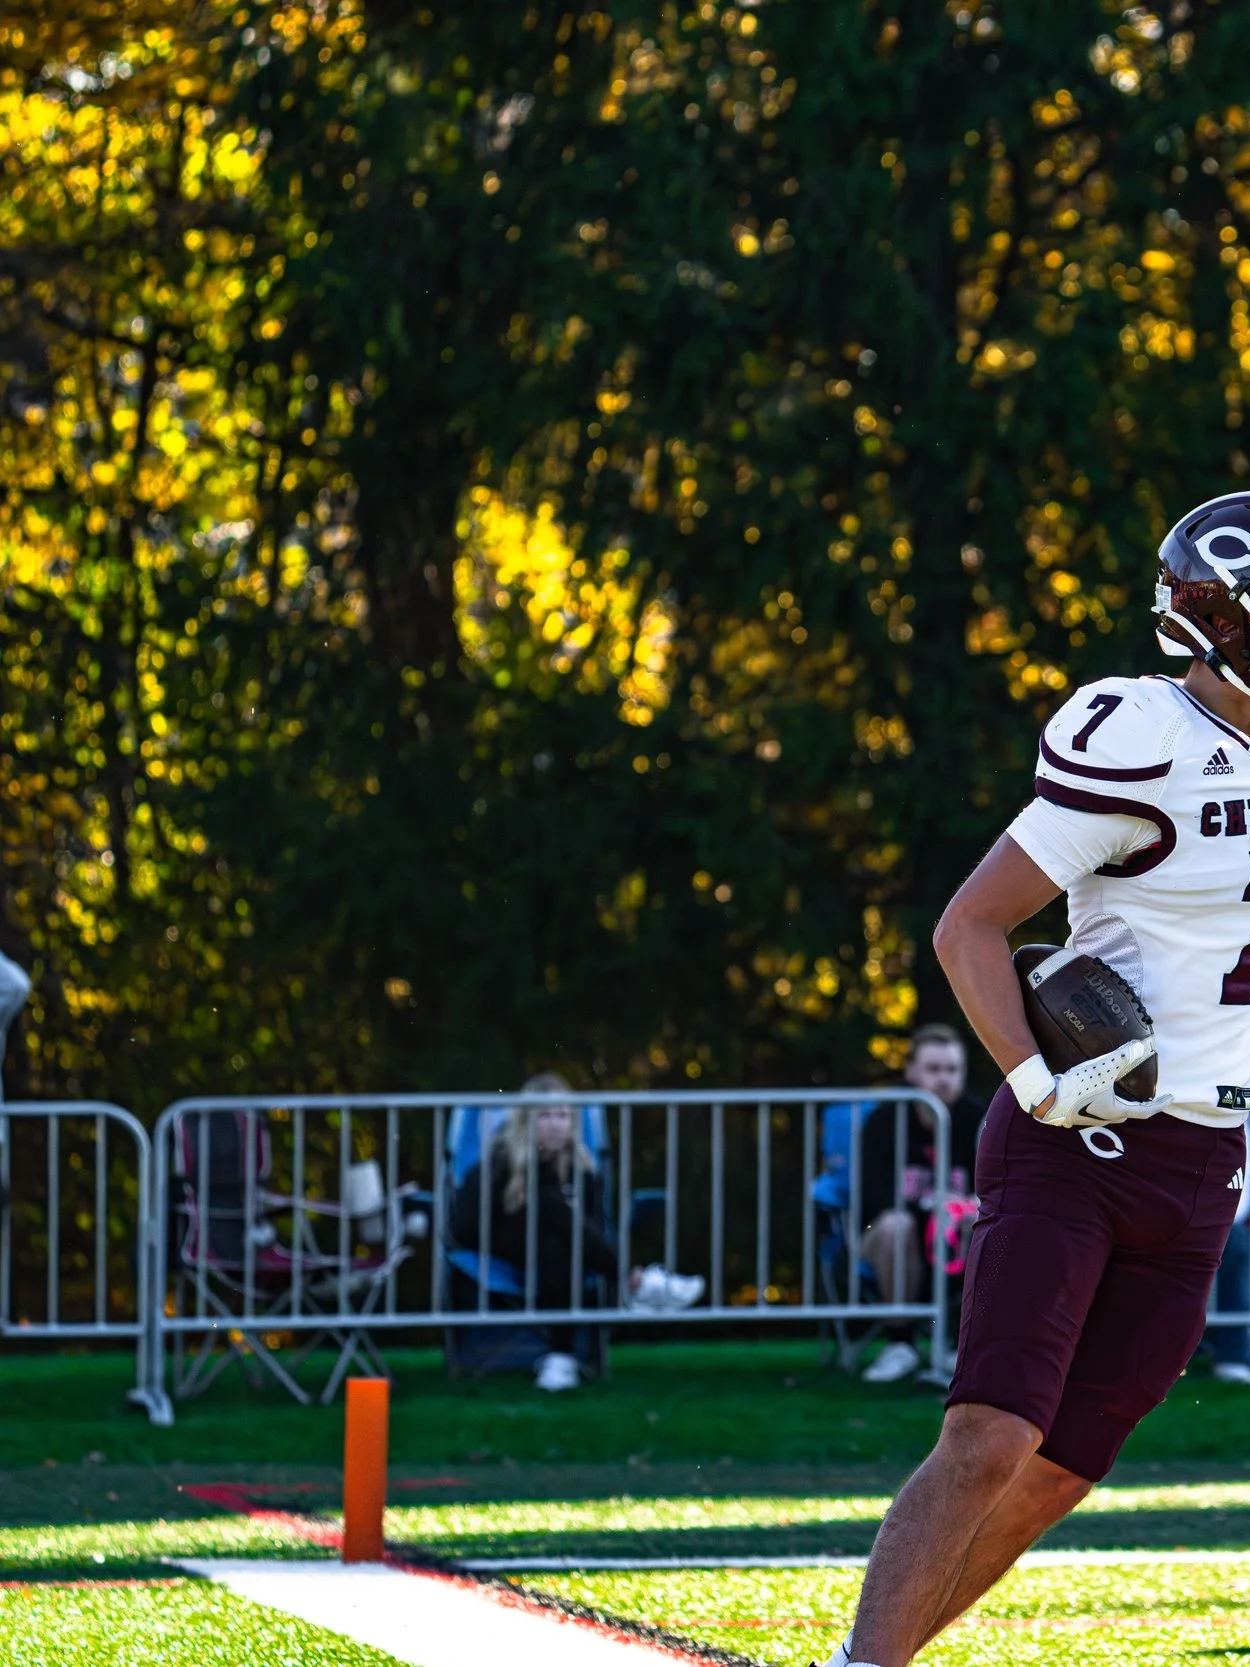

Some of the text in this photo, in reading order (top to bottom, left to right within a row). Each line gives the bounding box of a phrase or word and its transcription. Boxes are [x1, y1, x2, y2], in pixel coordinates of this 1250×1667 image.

[1071, 693, 1124, 752] 7
[1202, 763, 1235, 776] adidas
[1084, 970, 1128, 1026] Wilson
[1063, 1008, 1086, 1033] NCAA
